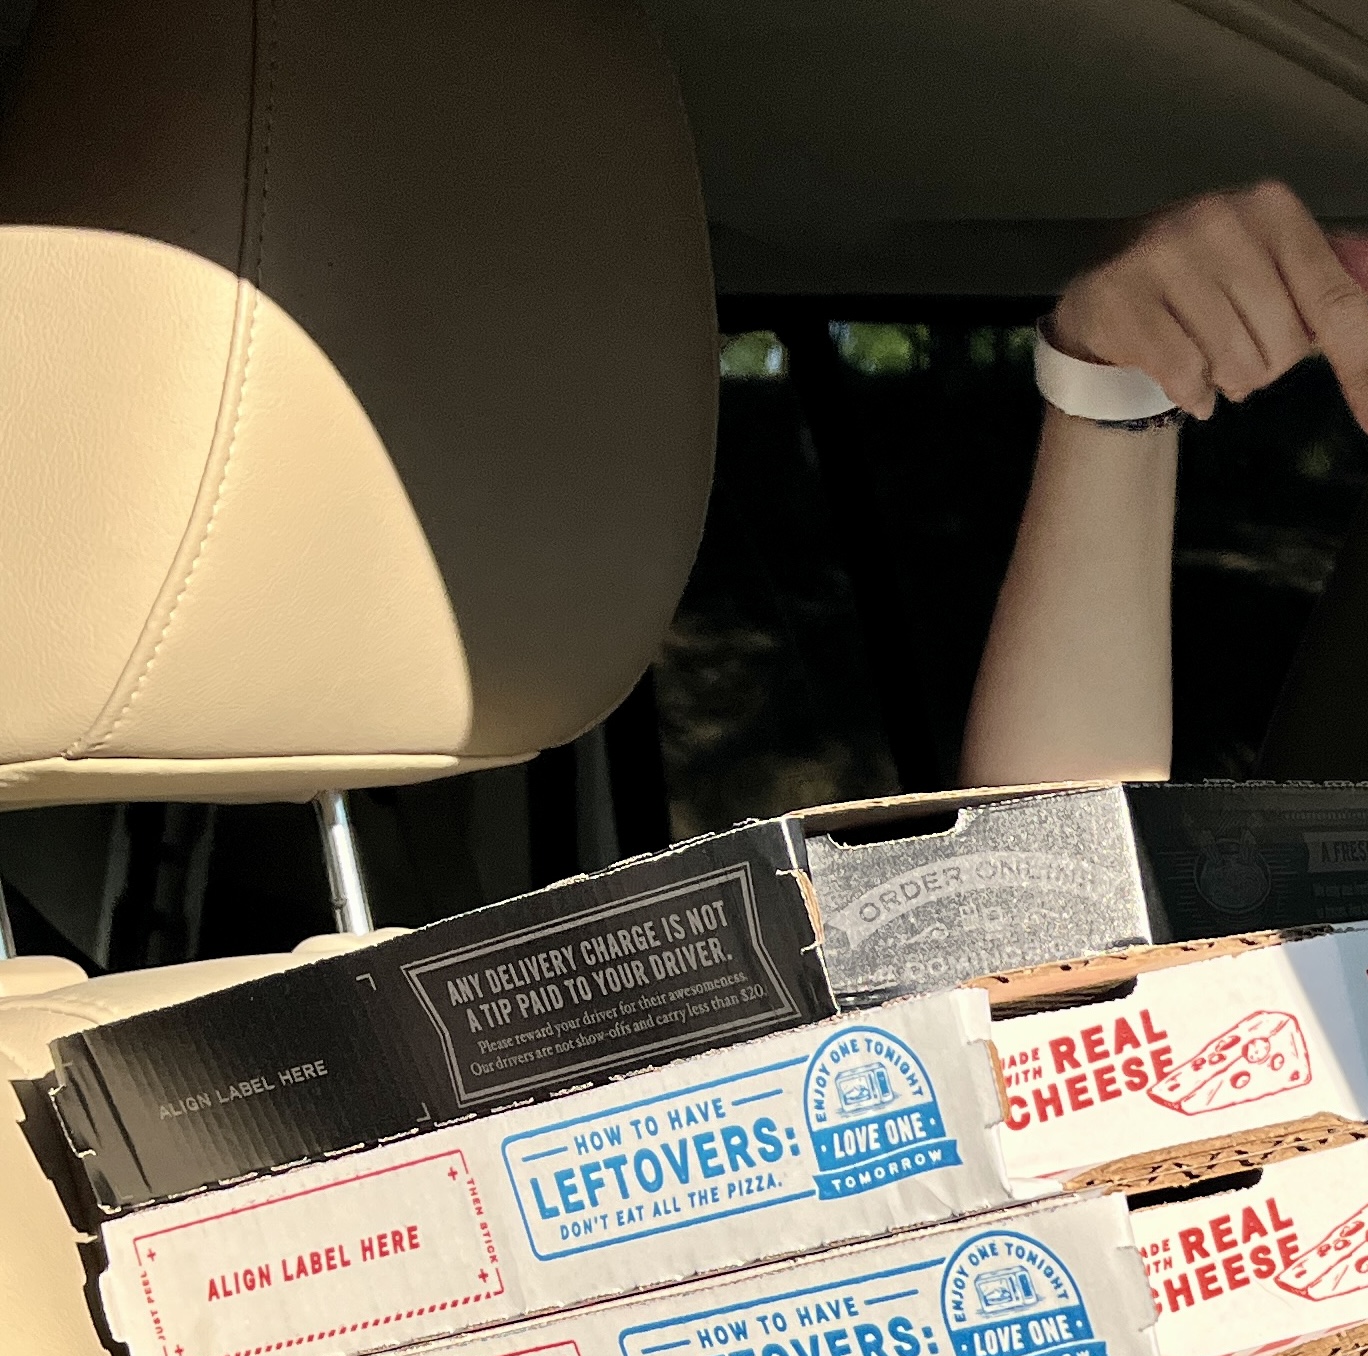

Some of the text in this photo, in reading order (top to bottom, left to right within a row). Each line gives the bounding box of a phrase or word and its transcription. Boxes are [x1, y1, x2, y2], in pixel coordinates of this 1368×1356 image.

[1321, 842, 1331, 862] A
[859, 866, 964, 923] ORDER
[447, 900, 730, 1006] ANY DELIVERY CHARGE IS NOT
[466, 937, 734, 1033] A TIP PAID TO YOUR DRIVER.
[470, 983, 767, 1077] Our drivers are not show-offs and carry less than $20.
[477, 971, 749, 1056] Please reward your driver for their awesomeness.
[1049, 1009, 1168, 1074] REAL
[160, 1060, 328, 1120] ALIGN LABEL HERE
[814, 1039, 923, 1122] ENJOY ONE TONIGHT
[1001, 1047, 1040, 1070] ADE
[1007, 1046, 1174, 1131] CHEESE
[575, 1099, 726, 1155] HOW TO HAVE
[833, 1112, 926, 1158] LOVE ONE
[531, 1117, 800, 1220] LEFTOVERS:
[831, 1149, 942, 1193] TOMORROW
[466, 1179, 498, 1263] THEN STICK
[560, 1174, 782, 1240] DON'T EAT ALL THE PIZZA.
[1179, 1198, 1293, 1264] REAL
[208, 1226, 420, 1301] ALIGN LABEL HERE
[139, 1271, 166, 1340] JUST PEEL
[973, 1314, 1072, 1356] LOVE ONE
